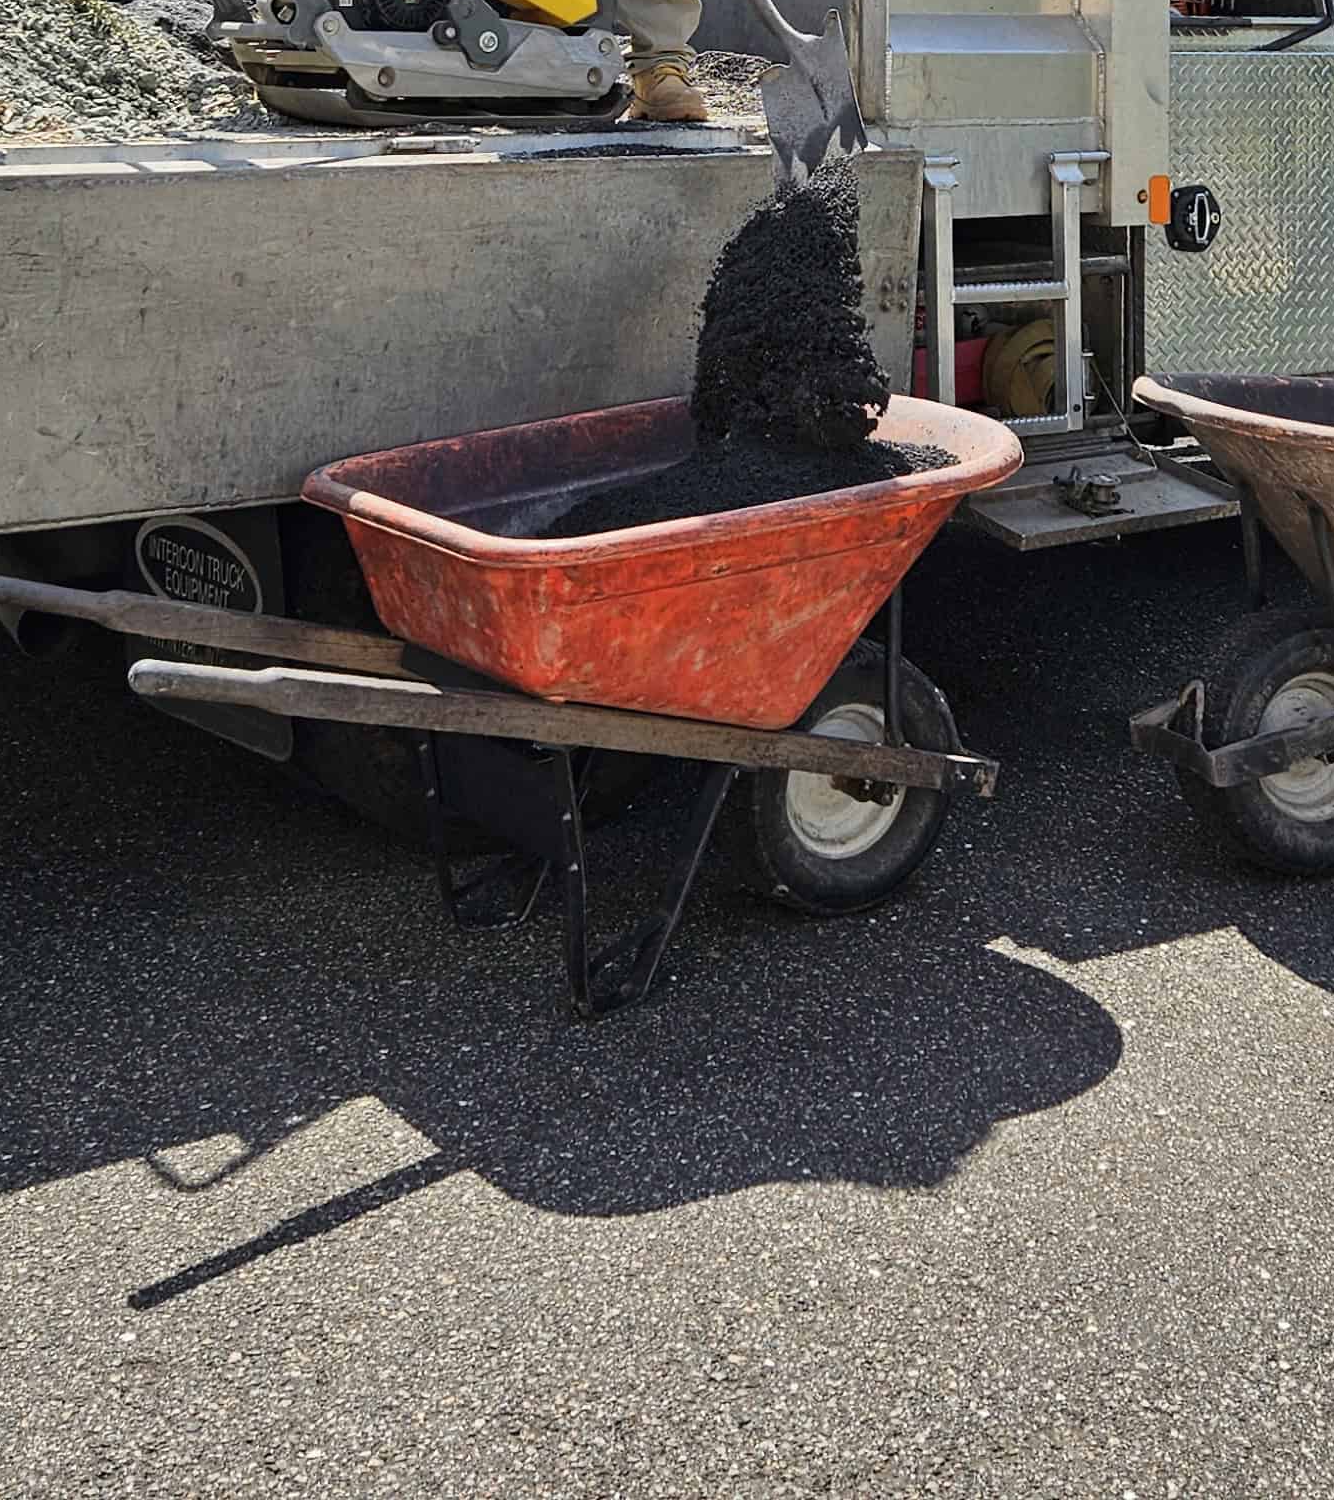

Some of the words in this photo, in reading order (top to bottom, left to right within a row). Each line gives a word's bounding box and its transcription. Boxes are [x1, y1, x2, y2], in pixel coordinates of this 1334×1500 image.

[149, 535, 204, 576] INTERCON
[205, 554, 245, 593] TRUCK
[165, 567, 230, 609] EQUIPMENT
